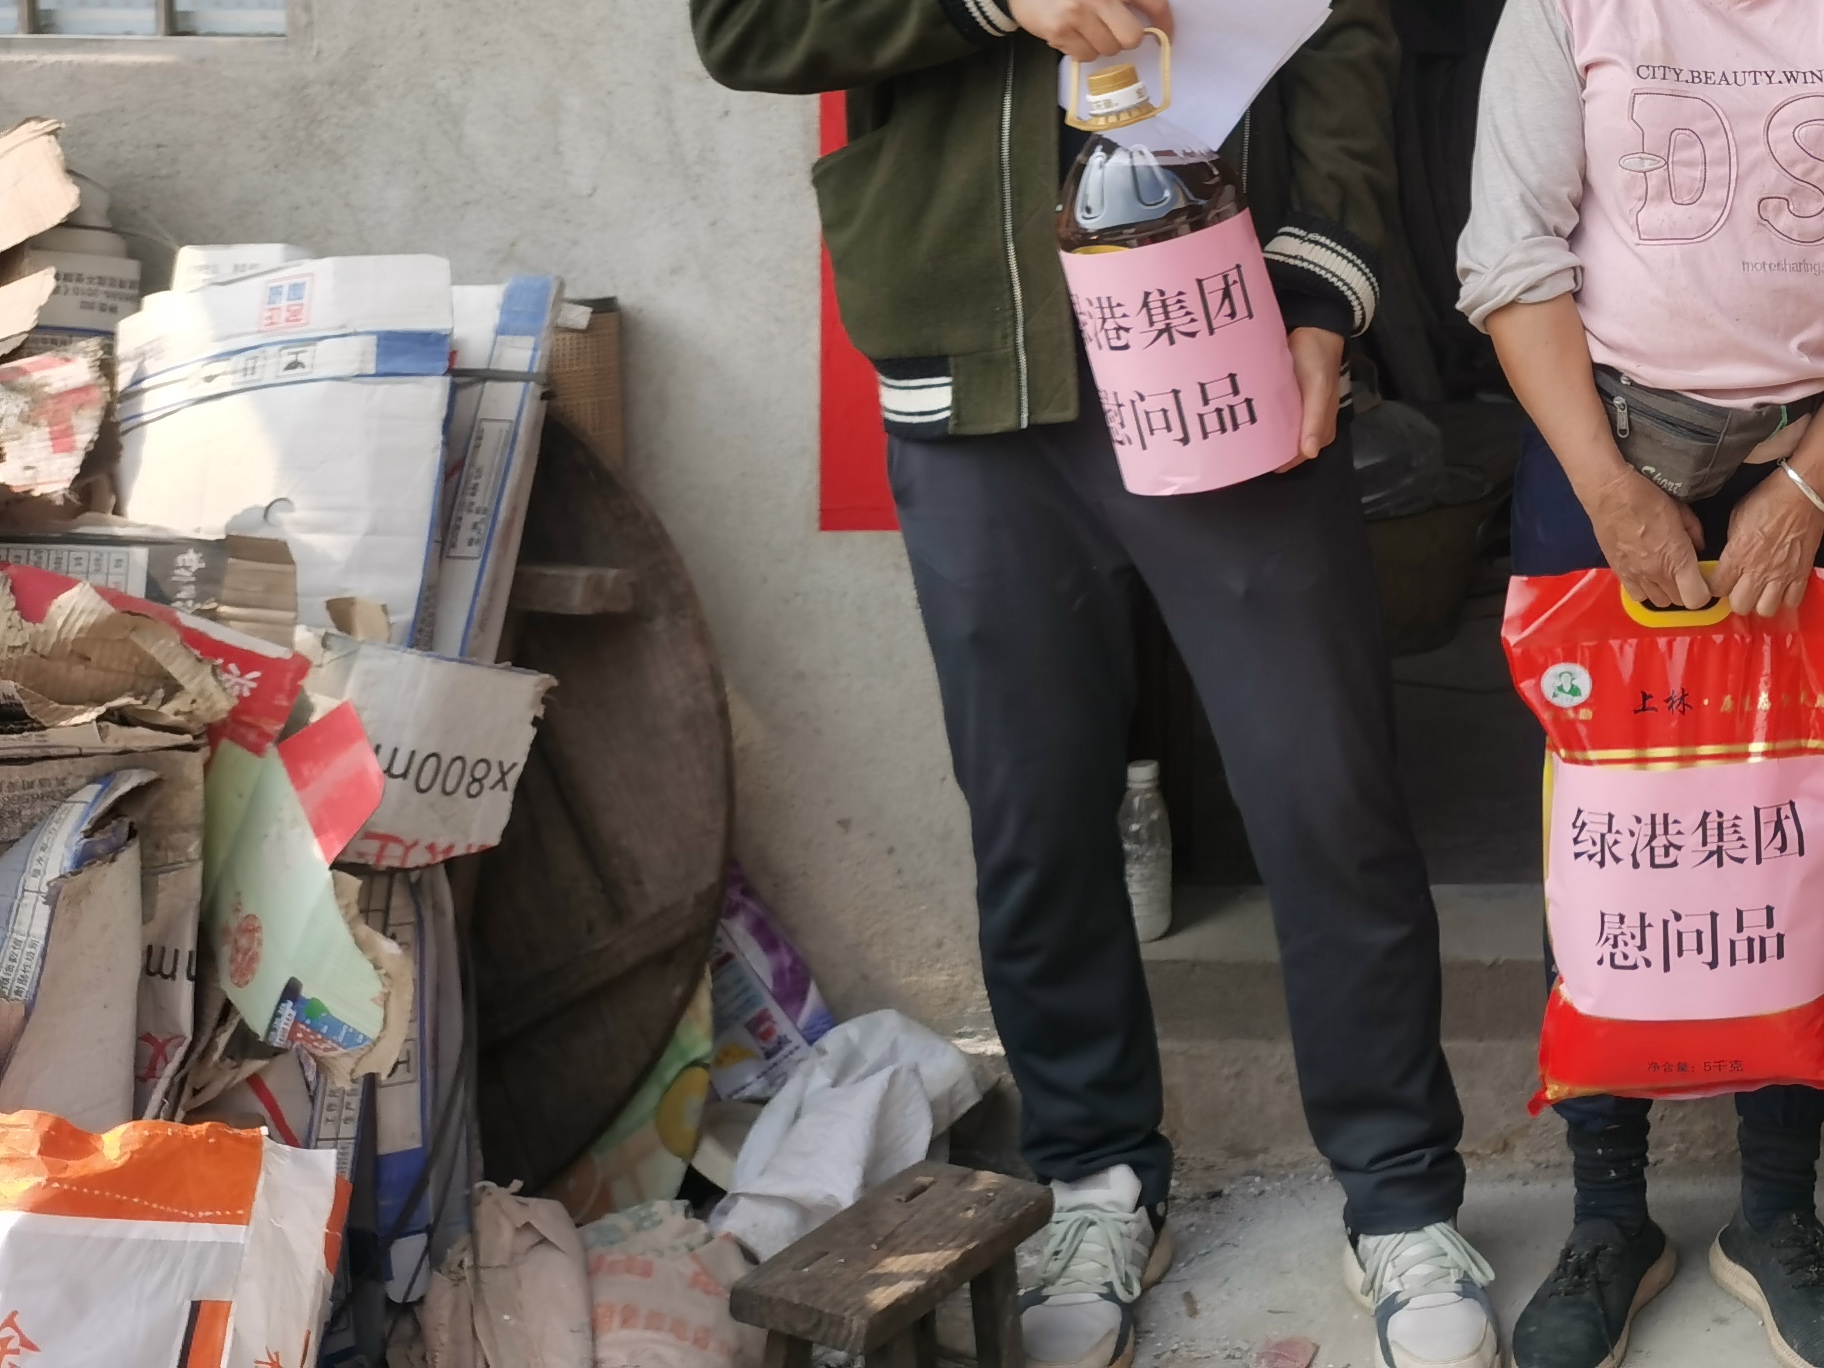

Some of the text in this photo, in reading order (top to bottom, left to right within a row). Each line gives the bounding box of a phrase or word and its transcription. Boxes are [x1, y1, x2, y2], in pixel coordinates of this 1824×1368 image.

[1633, 687, 1694, 716] 上林
[1570, 797, 1807, 871] 绿港集团
[1595, 902, 1787, 974] 慰问品
